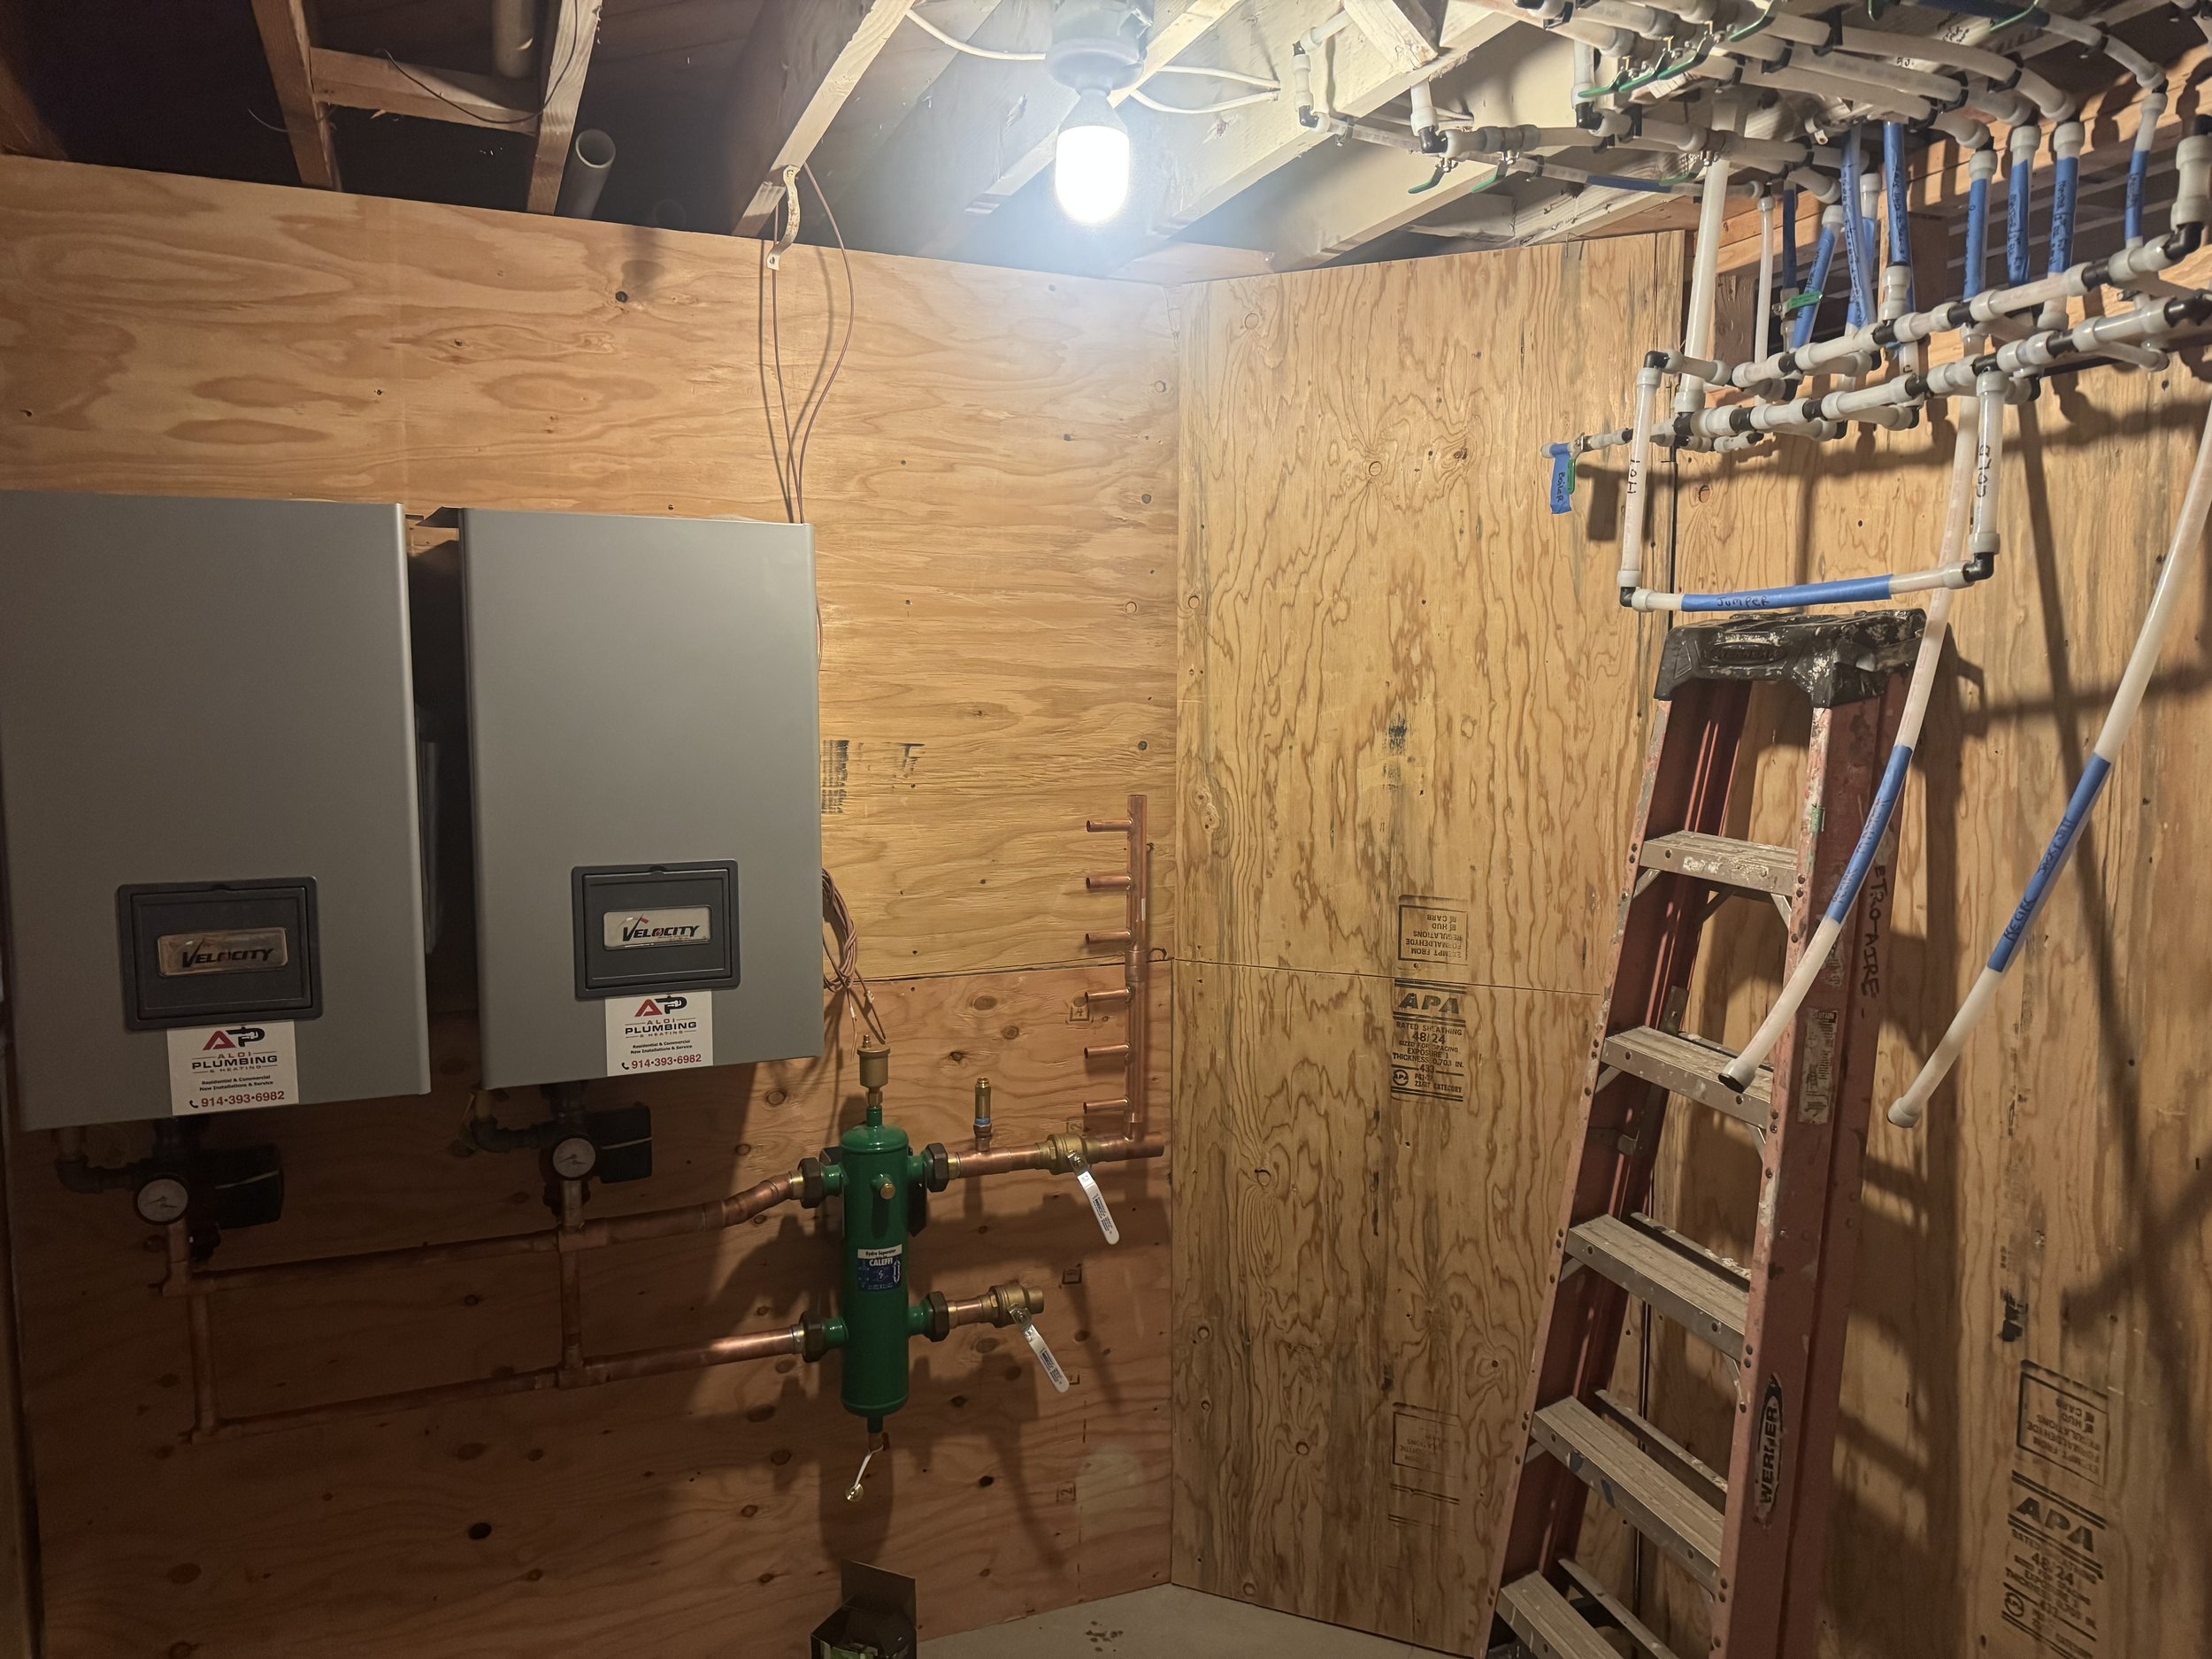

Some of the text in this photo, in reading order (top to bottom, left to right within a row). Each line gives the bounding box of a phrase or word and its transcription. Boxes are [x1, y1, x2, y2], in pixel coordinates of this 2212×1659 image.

[623, 913, 700, 941] VELOCITY
[182, 938, 274, 968] VELOCITY
[1398, 993, 1460, 1014] APA
[626, 1021, 697, 1034] PLUMBING
[1395, 1021, 1419, 1030] RATED
[1412, 1031, 1446, 1044] 48/24
[1392, 1052, 1430, 1063] THICKNESS
[1407, 1048, 1442, 1058] EXPOSURE
[192, 1056, 278, 1069] PLUMBING
[869, 1257, 894, 1267] CALEFFI
[2016, 1496, 2093, 1553] APA
